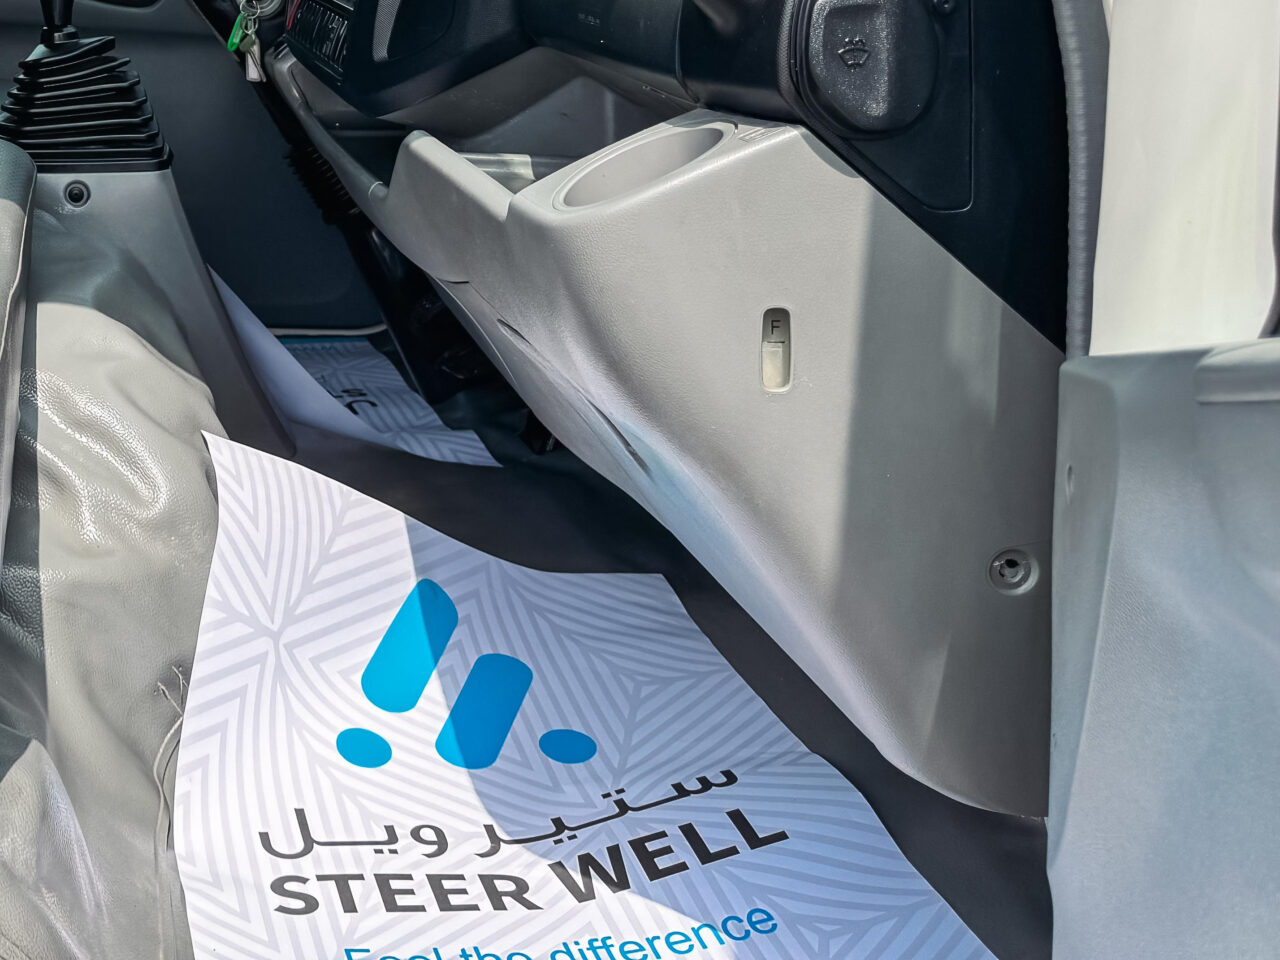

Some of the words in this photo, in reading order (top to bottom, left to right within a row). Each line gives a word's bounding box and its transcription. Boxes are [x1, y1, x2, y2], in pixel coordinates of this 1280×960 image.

[771, 319, 781, 335] F
[259, 807, 448, 859] ويل
[473, 768, 739, 859] ستير
[269, 873, 543, 915] STEER
[548, 808, 790, 903] WELL
